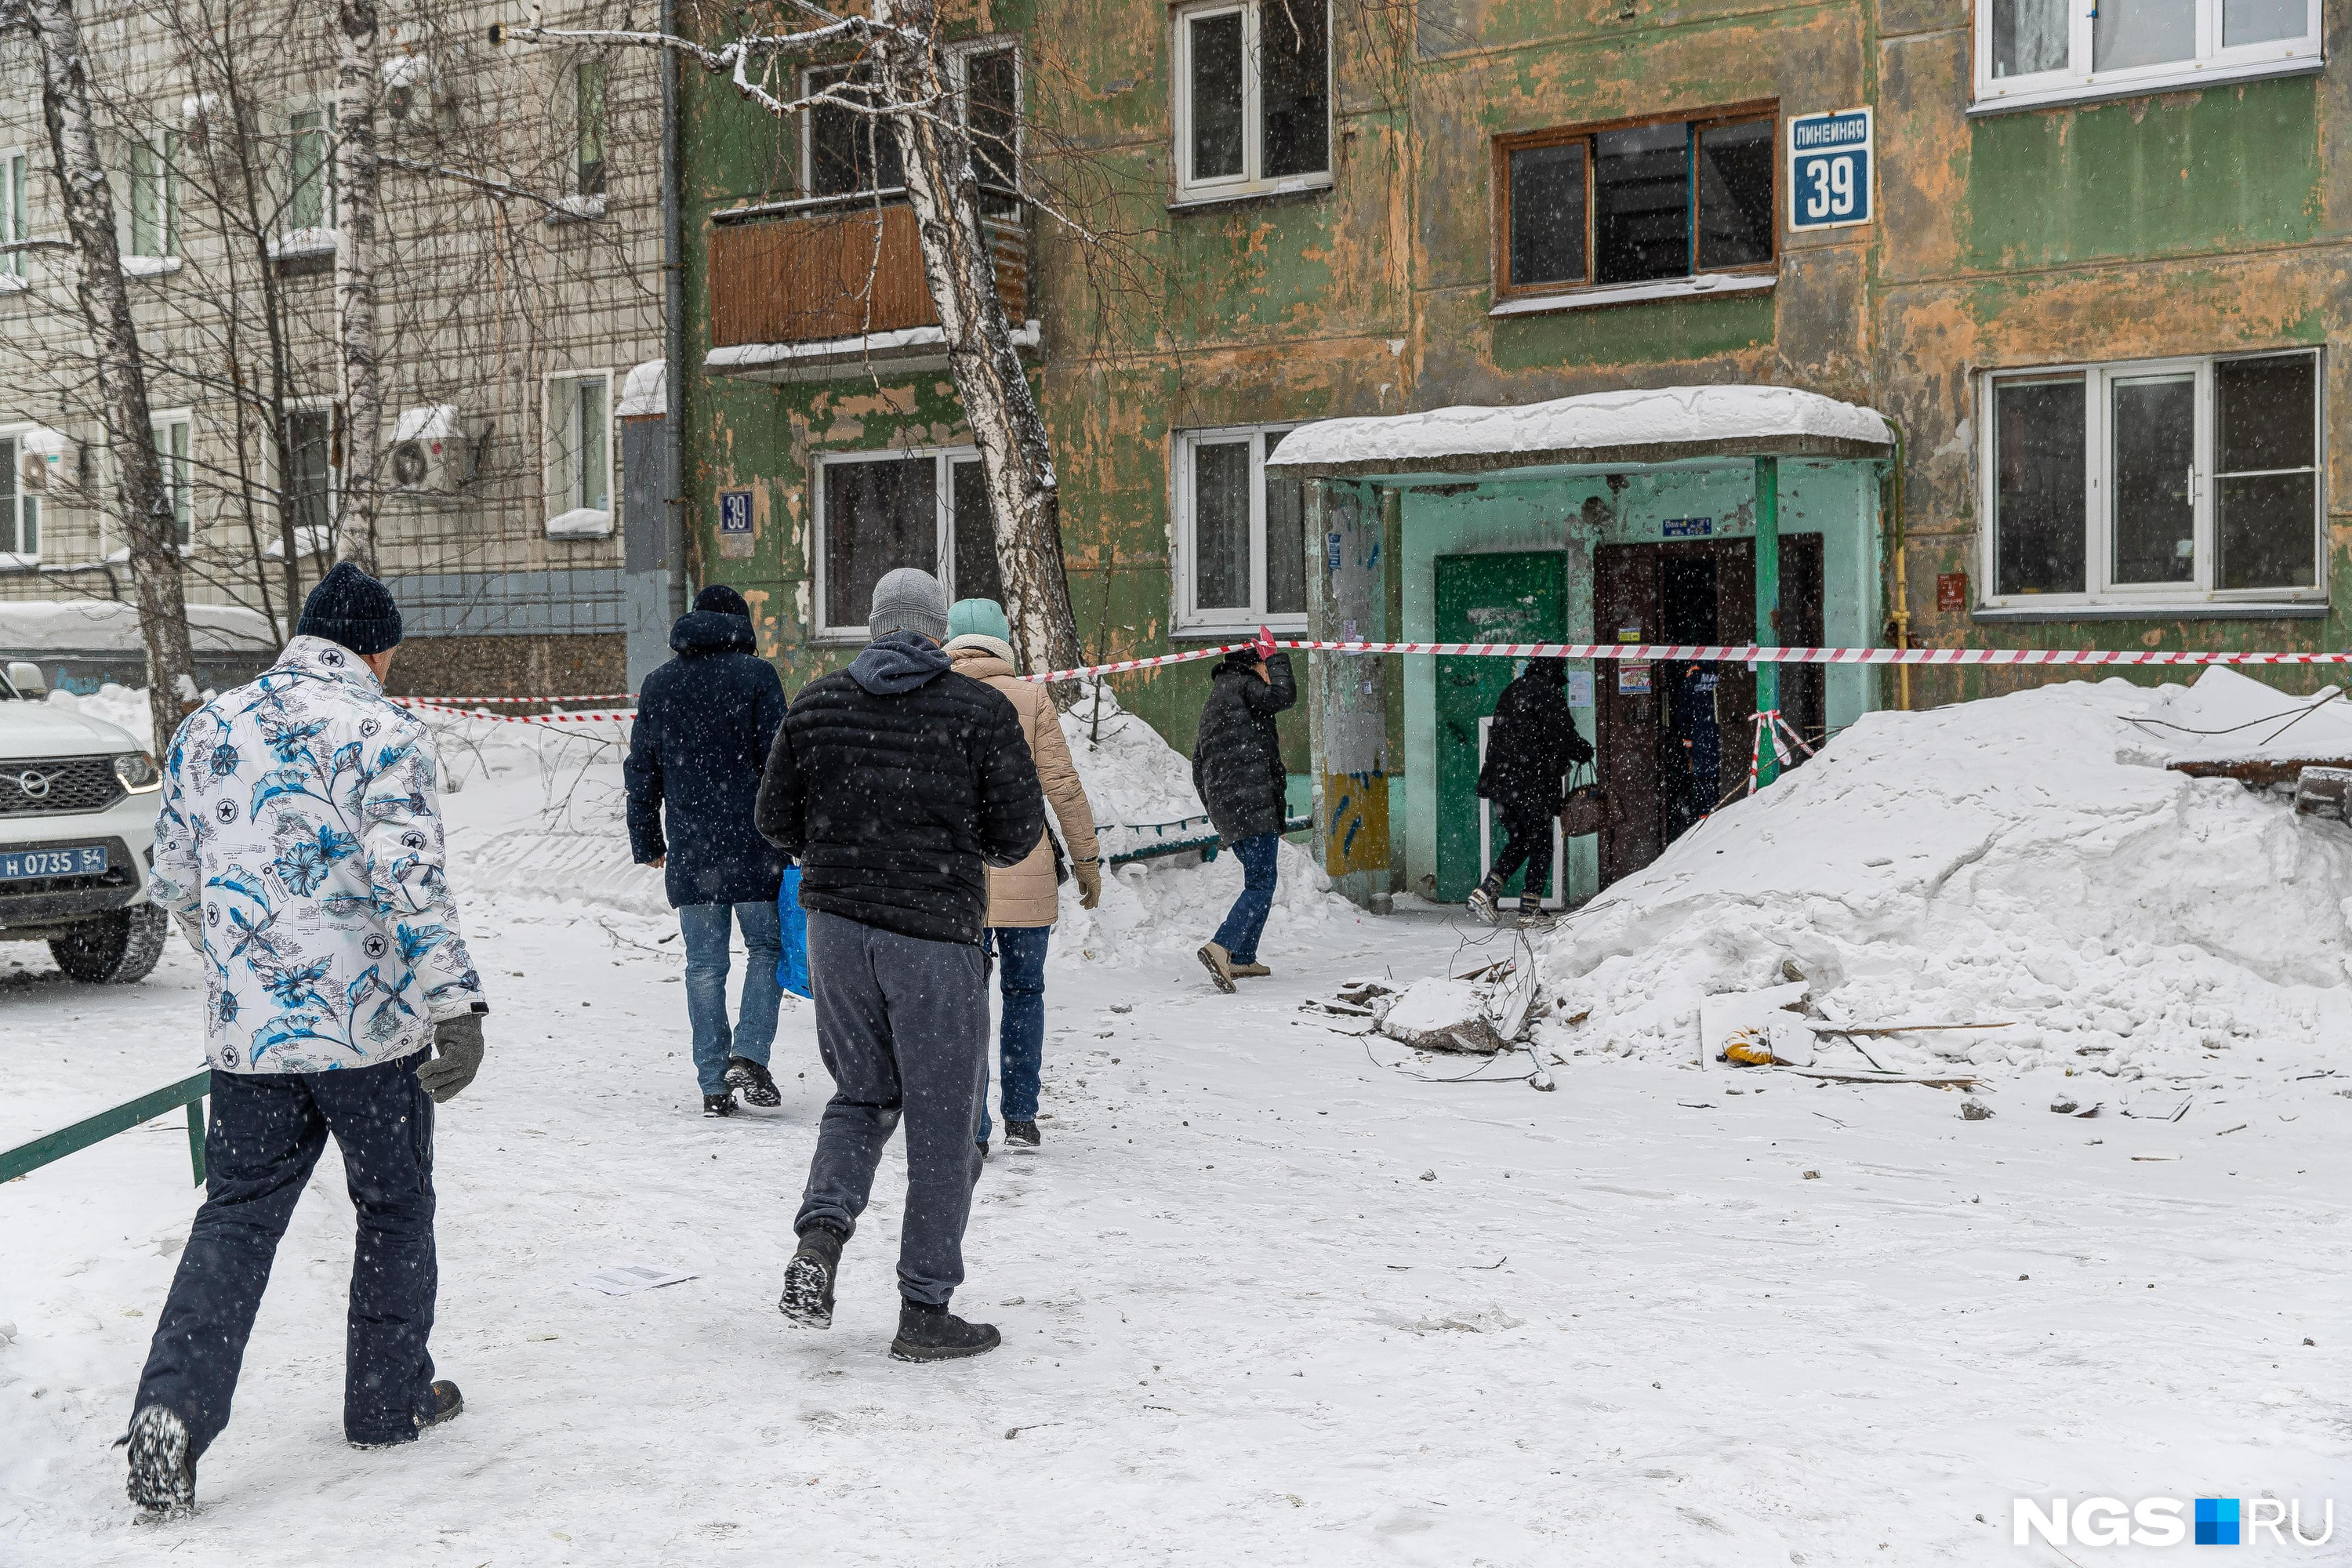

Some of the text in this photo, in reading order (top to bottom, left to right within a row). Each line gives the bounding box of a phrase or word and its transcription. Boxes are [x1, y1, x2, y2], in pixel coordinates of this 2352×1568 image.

[1796, 119, 1865, 146] ЛИНЕЙНАЯ
[1806, 156, 1854, 218] 39
[728, 495, 746, 529] 39
[5, 852, 72, 877] Н 0735
[81, 849, 101, 864] 54
